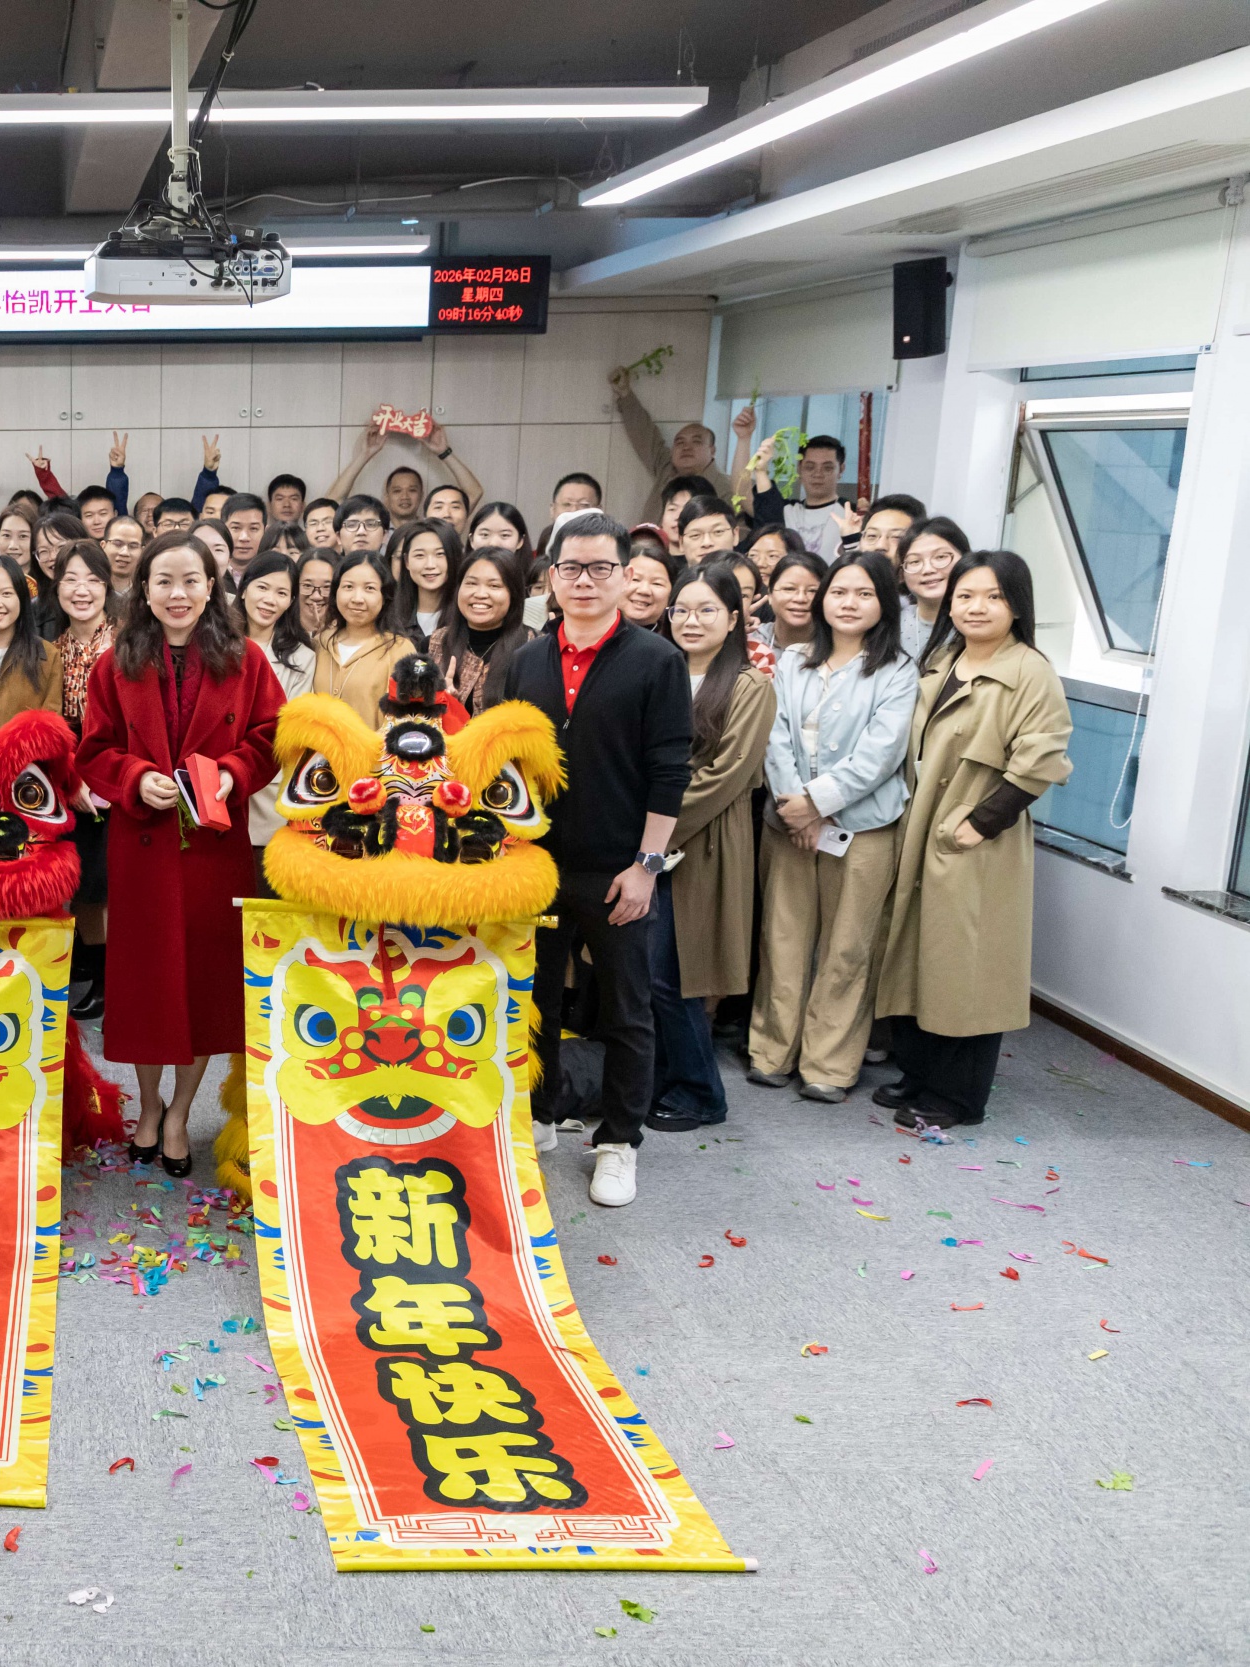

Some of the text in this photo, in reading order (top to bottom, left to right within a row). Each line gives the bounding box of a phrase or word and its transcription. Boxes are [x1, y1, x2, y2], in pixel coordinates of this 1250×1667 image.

[434, 267, 531, 283] 2026年02月26日
[461, 286, 504, 302] 星期四
[438, 305, 523, 322] 09时16分40秒
[373, 405, 428, 436] 开业大吉
[341, 1161, 582, 1508] 新年快乐
